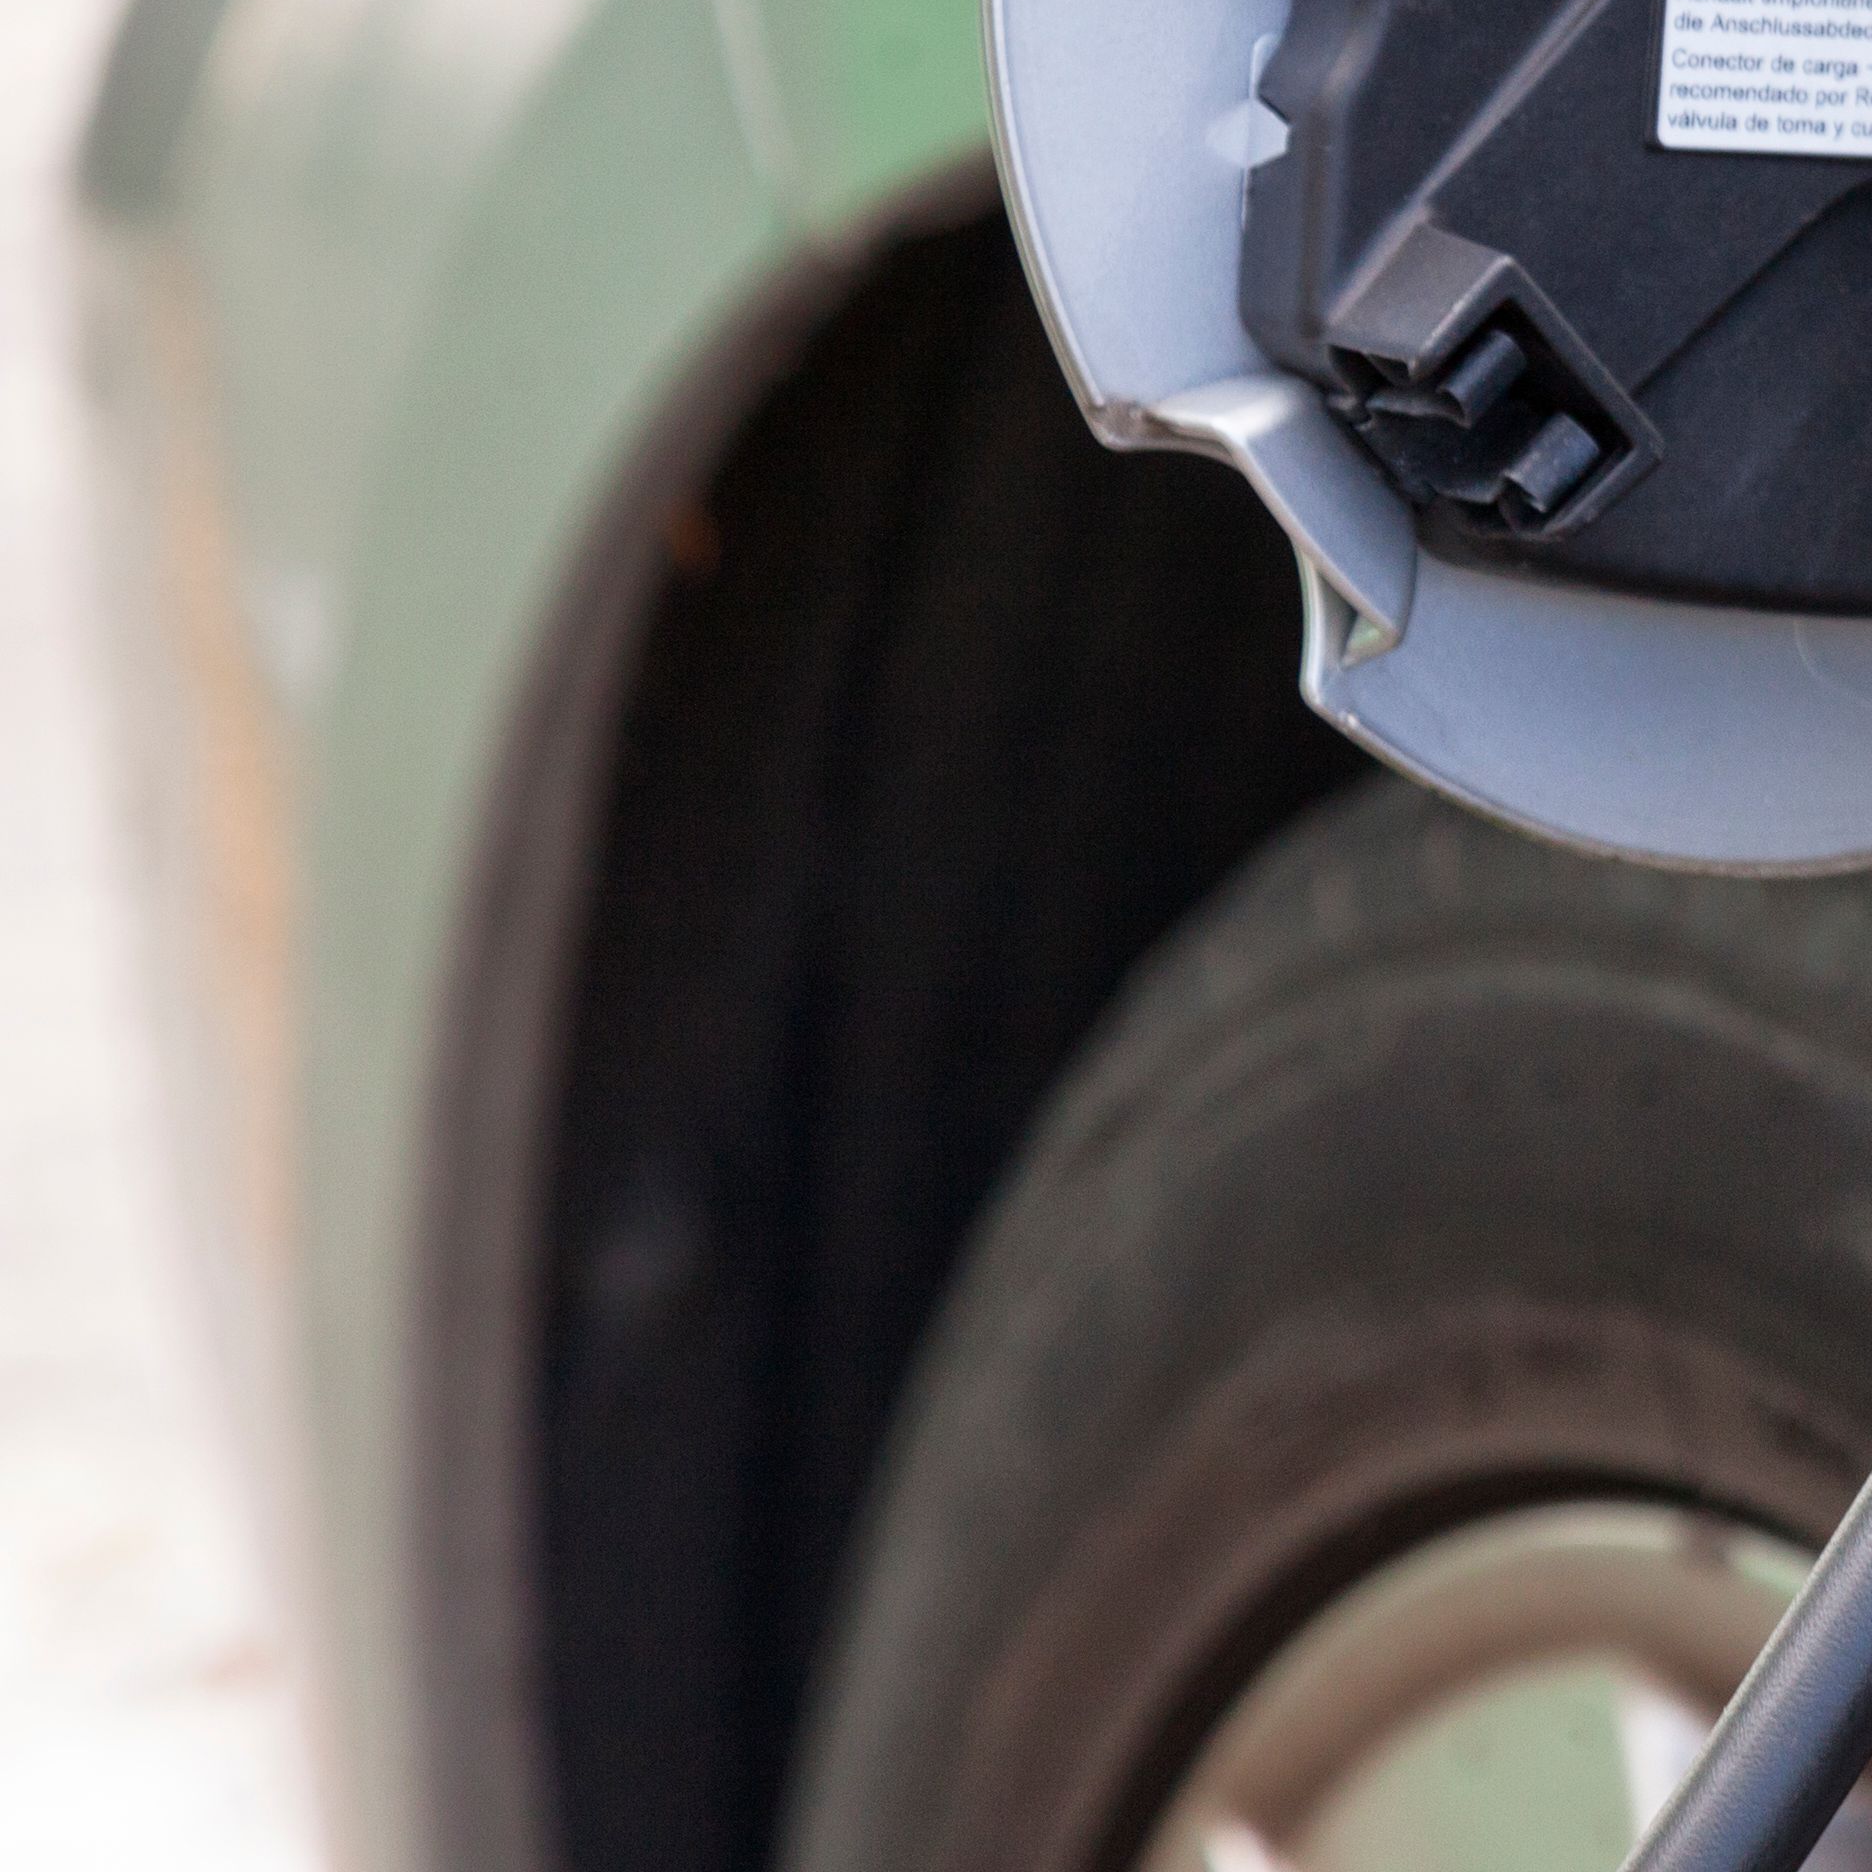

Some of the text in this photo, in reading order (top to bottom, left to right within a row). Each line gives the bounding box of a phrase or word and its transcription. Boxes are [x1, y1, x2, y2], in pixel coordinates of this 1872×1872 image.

[1673, 11, 1704, 31] die
[1671, 47, 1763, 71] Conector
[1770, 54, 1796, 73] de
[1802, 58, 1859, 80] carga
[1669, 83, 1808, 104] recomendado
[1815, 89, 1847, 107] por
[1667, 109, 1738, 131] válvula
[1744, 113, 1769, 132] de
[1776, 115, 1827, 135] toma
[1833, 122, 1843, 138] y
